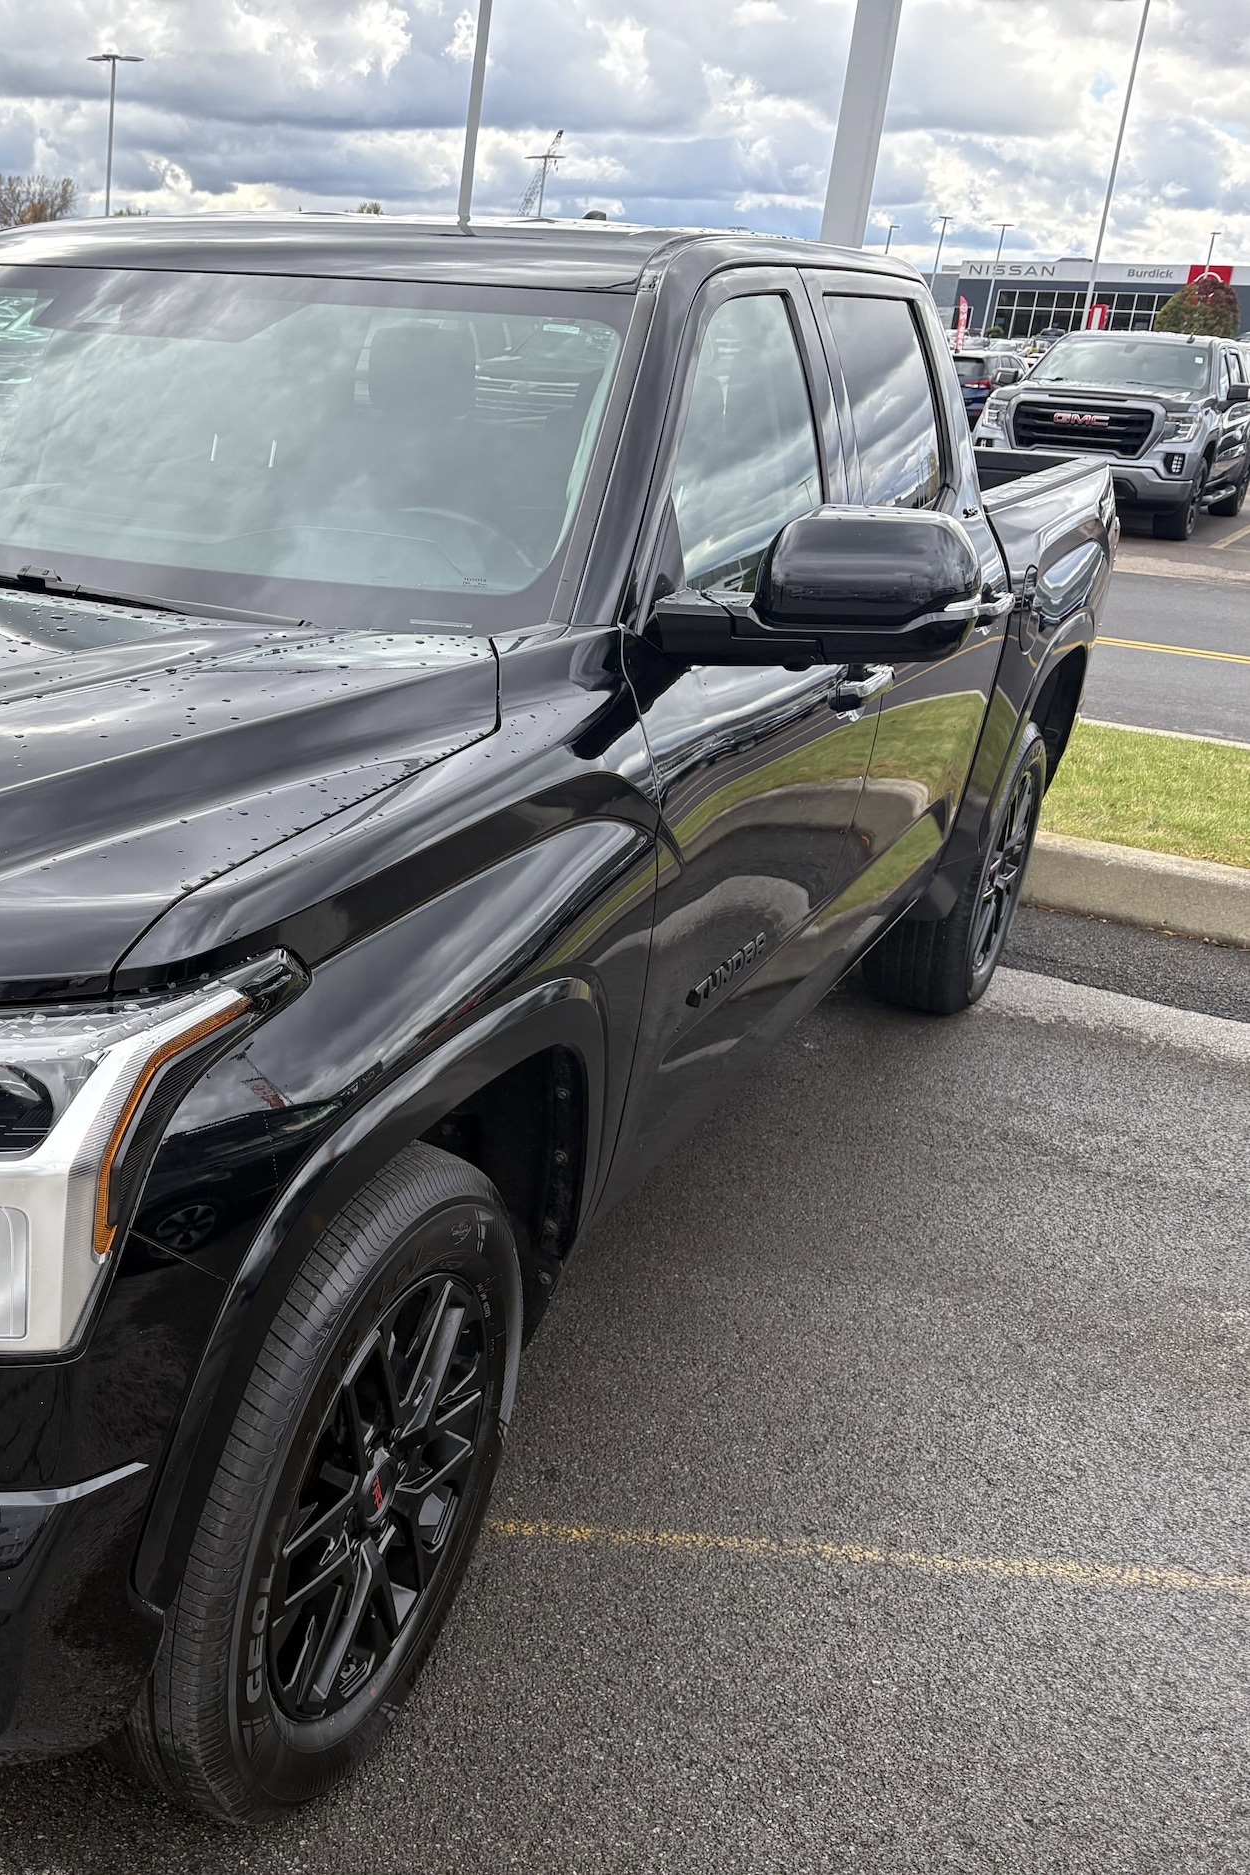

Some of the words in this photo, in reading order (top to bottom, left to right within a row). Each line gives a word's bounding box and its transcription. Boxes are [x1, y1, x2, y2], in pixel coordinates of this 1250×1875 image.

[968, 264, 1056, 277] NISSAN
[1127, 267, 1174, 280] Burdick
[1053, 412, 1110, 427] GMC
[690, 930, 767, 1007] TUNDRA
